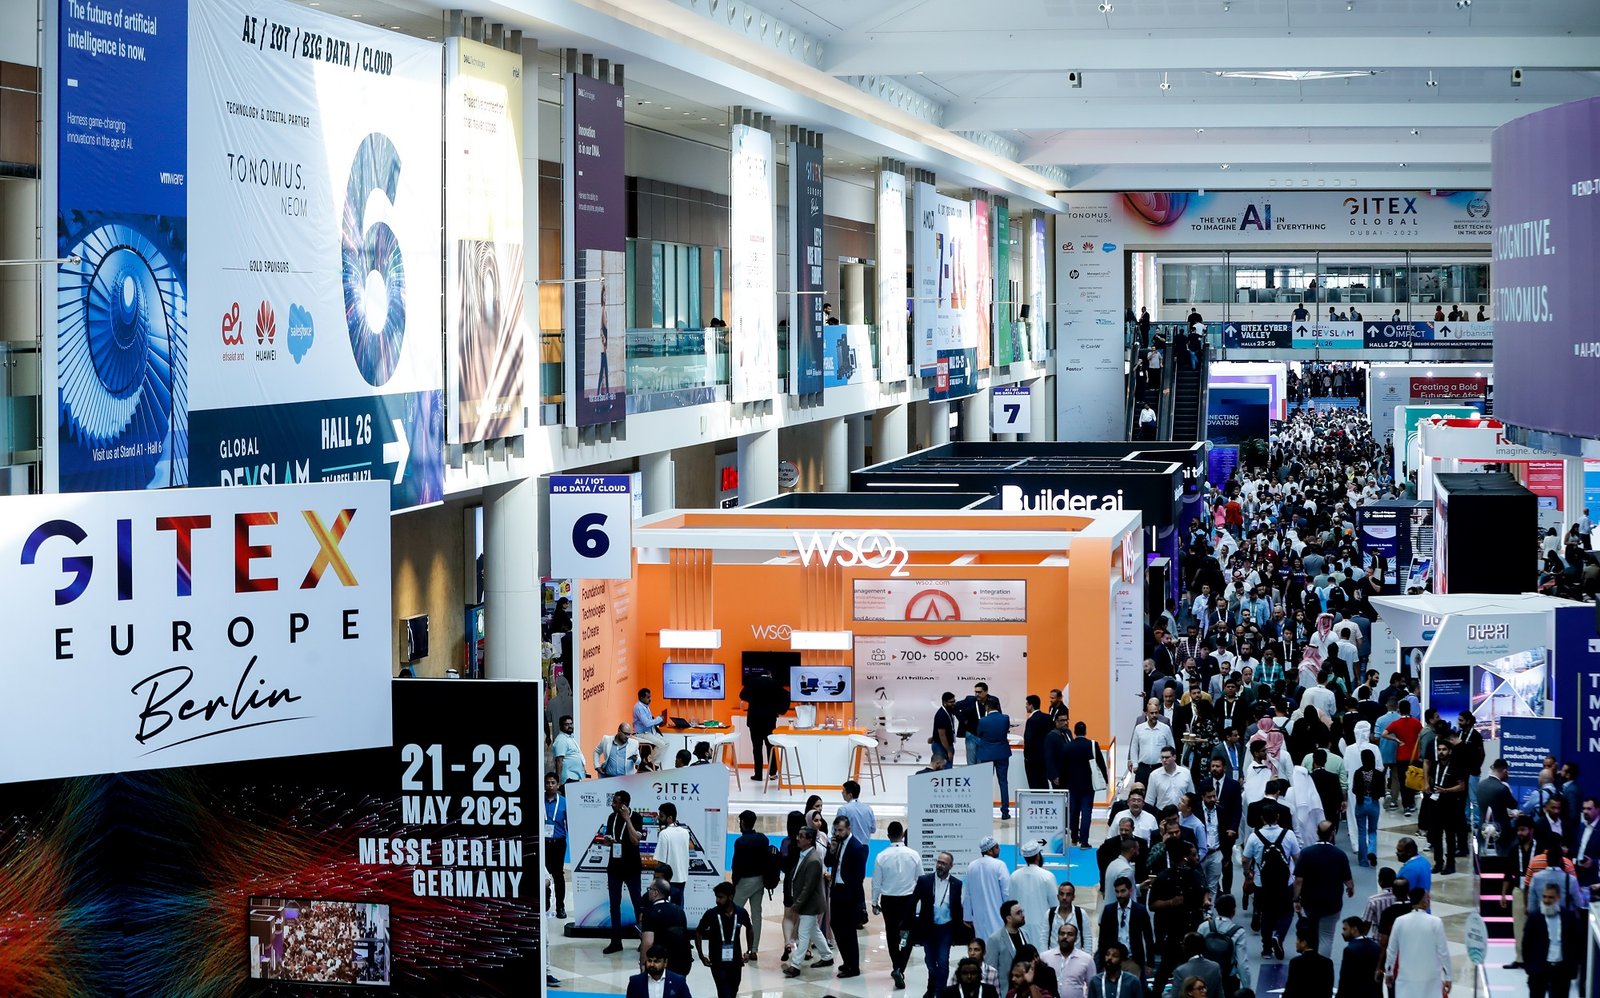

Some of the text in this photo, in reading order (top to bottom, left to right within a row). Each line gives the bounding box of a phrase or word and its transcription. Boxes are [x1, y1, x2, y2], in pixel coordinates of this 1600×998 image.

[68, 0, 157, 35] The future of artificial
[67, 28, 146, 61] intelligence is now.
[242, 15, 258, 43] AI
[270, 23, 289, 51] IOT
[302, 30, 322, 61] BIG
[326, 37, 350, 68] DATA
[362, 47, 393, 76] CLOUD
[67, 112, 126, 133] Harness game-changing
[226, 101, 310, 128] TECHNOLOGY & DIGITAL PARTNER
[66, 133, 95, 145] innovations
[95, 134, 101, 145] in
[101, 135, 110, 146] the
[110, 138, 121, 149] age
[121, 136, 127, 147] of
[160, 172, 184, 185] vmware
[227, 153, 306, 191] TONOMUS.
[281, 197, 308, 217] NEOM
[1343, 197, 1417, 215] GITEX
[1239, 204, 1271, 230] AI
[1350, 218, 1418, 226] GLOBAL
[1498, 218, 1556, 260] COGNITIVE.
[249, 260, 290, 274] GOLD SPONSORS
[341, 132, 406, 387] 6
[290, 326, 312, 338] salesforce
[1396, 330, 1426, 338] IMPACT
[255, 349, 277, 361] HUAWEI
[1413, 383, 1449, 392] Creating
[1459, 383, 1478, 391] Bold
[1004, 404, 1020, 424] 7
[321, 413, 372, 450] HALL 26
[92, 448, 105, 461] Visit
[106, 451, 113, 460] us
[114, 448, 119, 459] at
[120, 444, 135, 458] Stand
[148, 441, 157, 455] Hall
[158, 440, 162, 454] 6
[220, 437, 259, 459] GLOBAL
[1496, 448, 1530, 456] imagine.
[1002, 485, 1124, 510] Builder.ai
[572, 512, 610, 558] 6
[20, 508, 359, 606] GITEX
[582, 583, 605, 600] Foundational
[582, 603, 606, 620] Technologies
[55, 609, 359, 660] EUROPE
[586, 625, 599, 639] Create
[582, 645, 601, 660] Awesome
[900, 651, 1000, 662] 700+ 5000+ 25k+
[582, 664, 595, 682] Digital
[131, 655, 302, 745] Berlin
[582, 682, 605, 701] Experiences
[652, 782, 700, 794] GITEX
[931, 777, 971, 787] GITEX
[402, 795, 522, 826] MAY 2025
[359, 837, 522, 867] MESSE BERLIN
[413, 869, 523, 898] GERMANY
